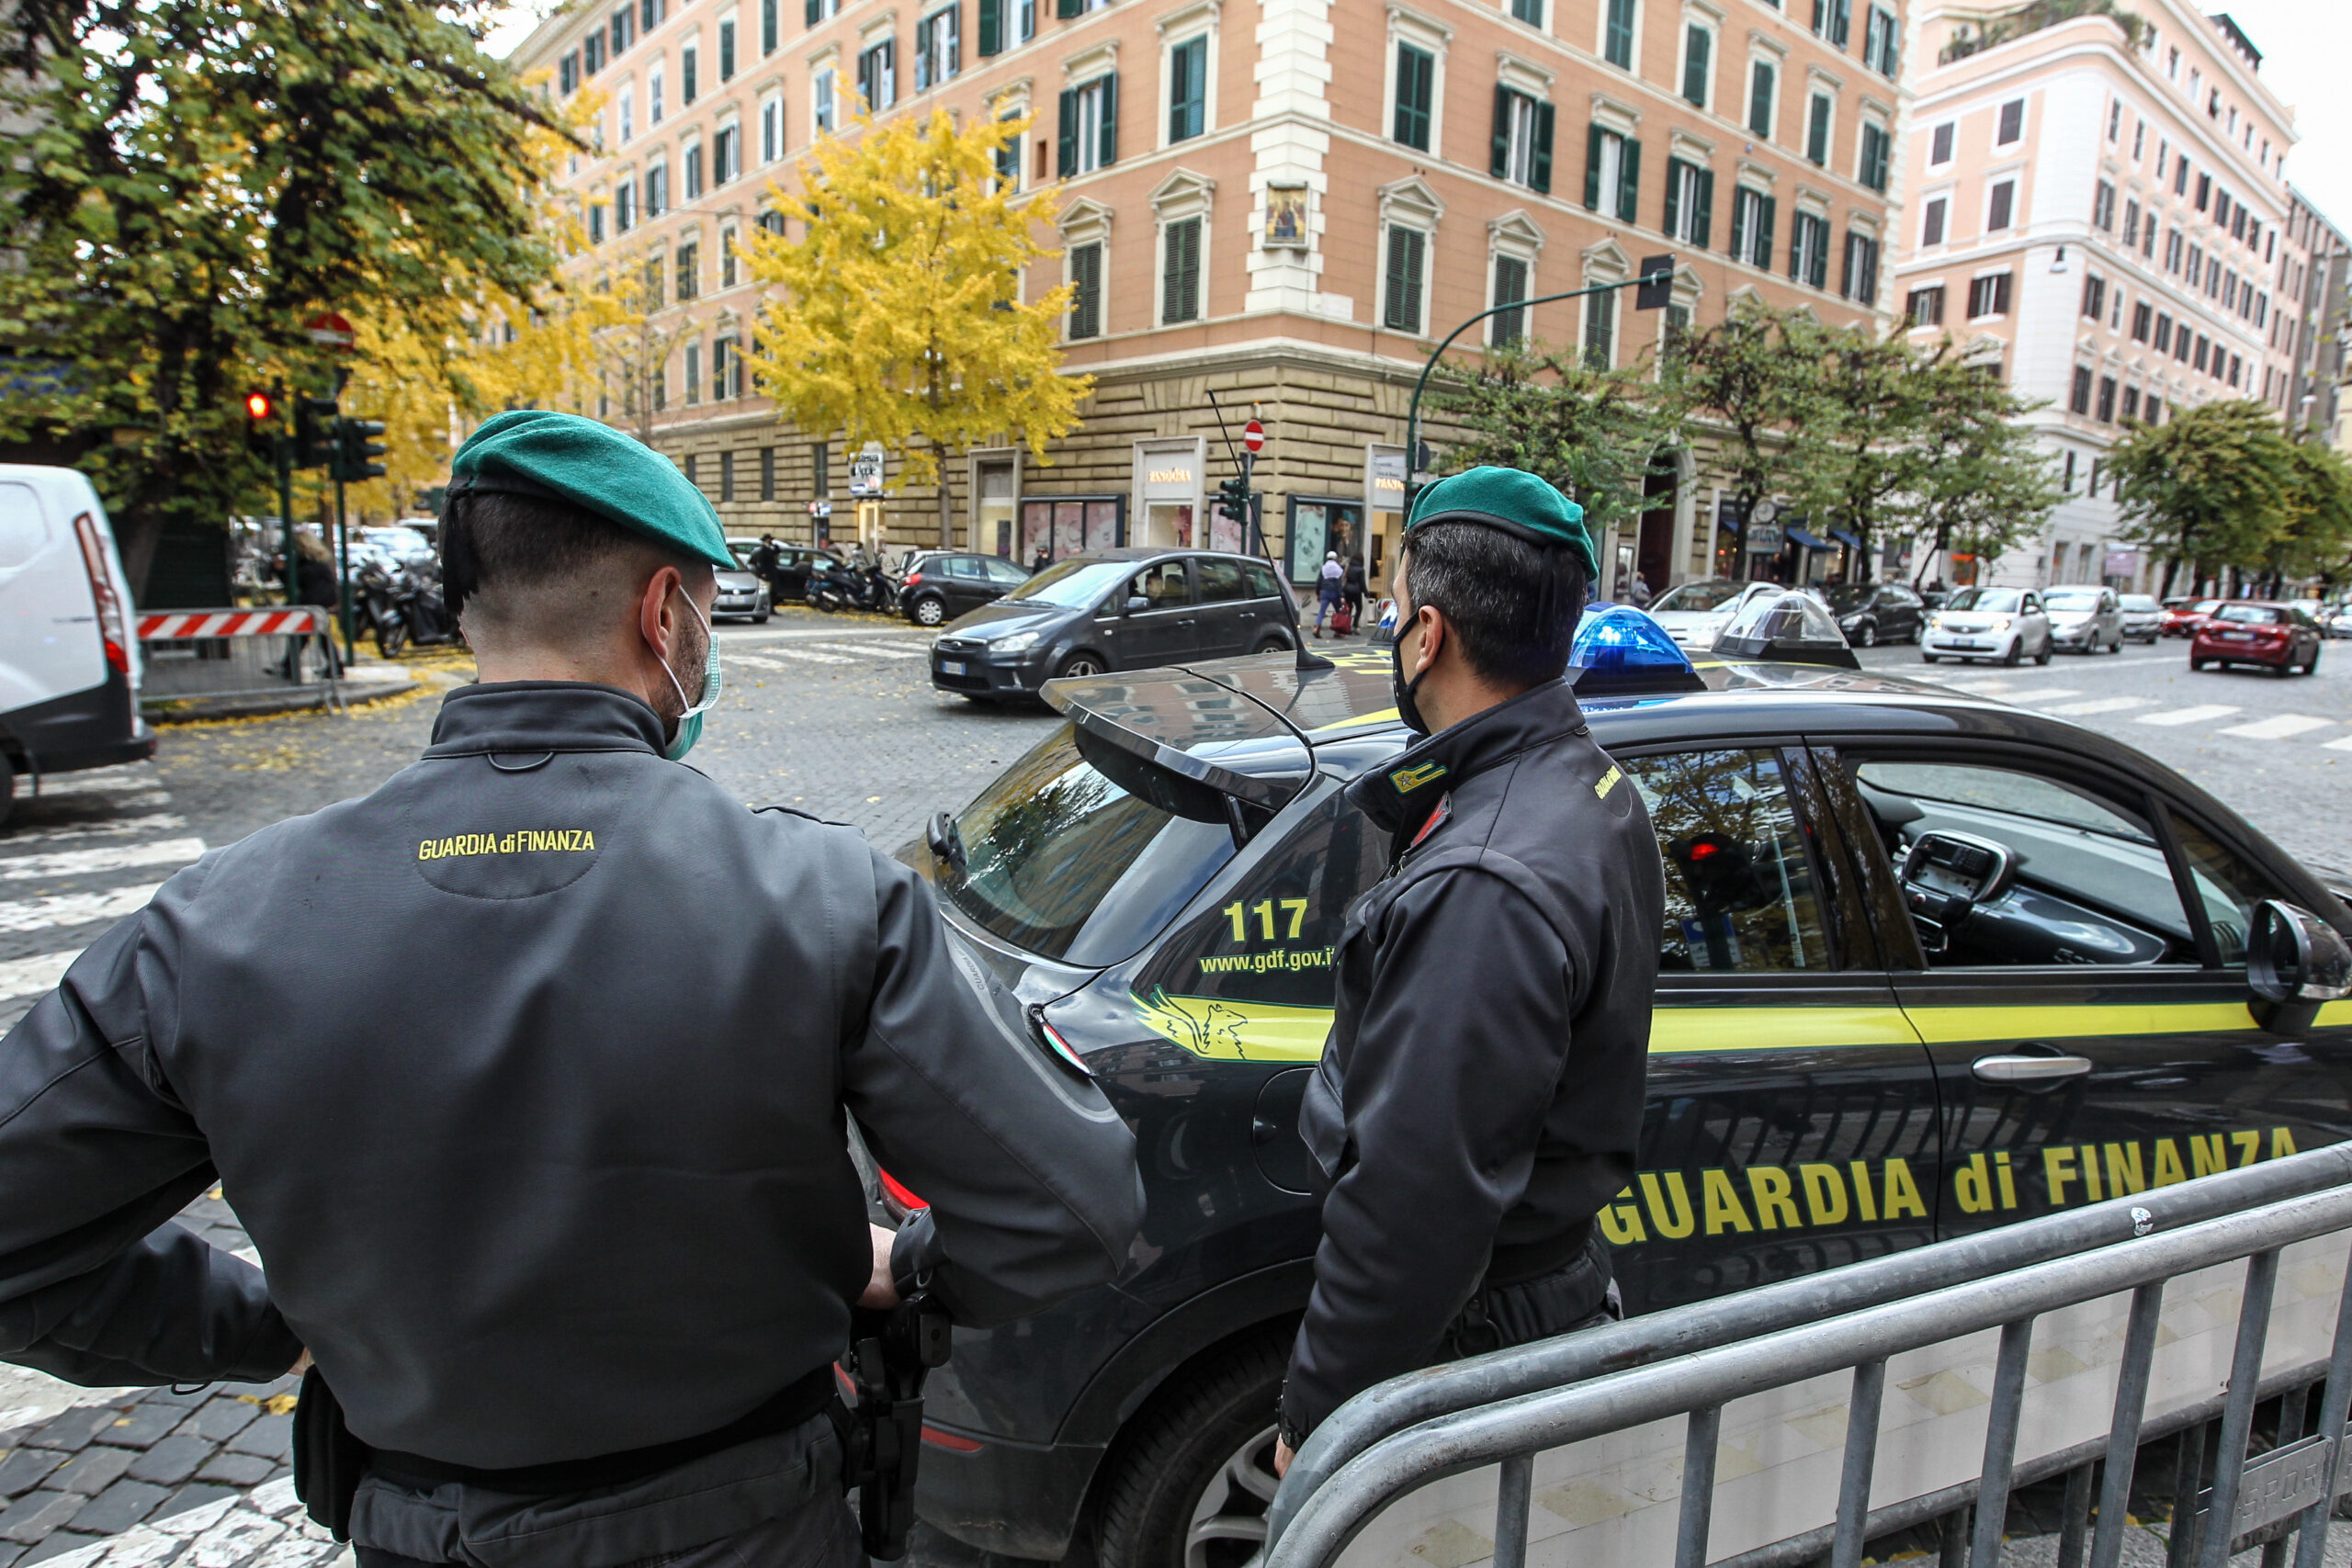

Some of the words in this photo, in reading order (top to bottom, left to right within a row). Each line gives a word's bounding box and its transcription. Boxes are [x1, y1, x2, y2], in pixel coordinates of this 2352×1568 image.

[1148, 468, 1192, 482] PANDORA
[418, 832, 497, 860] GUARDIA
[500, 834, 514, 853] di
[517, 830, 594, 852] FINANZA
[1224, 898, 1308, 942] 117
[1597, 1157, 1928, 1245] GUARDIA
[1954, 1151, 2018, 1213] di
